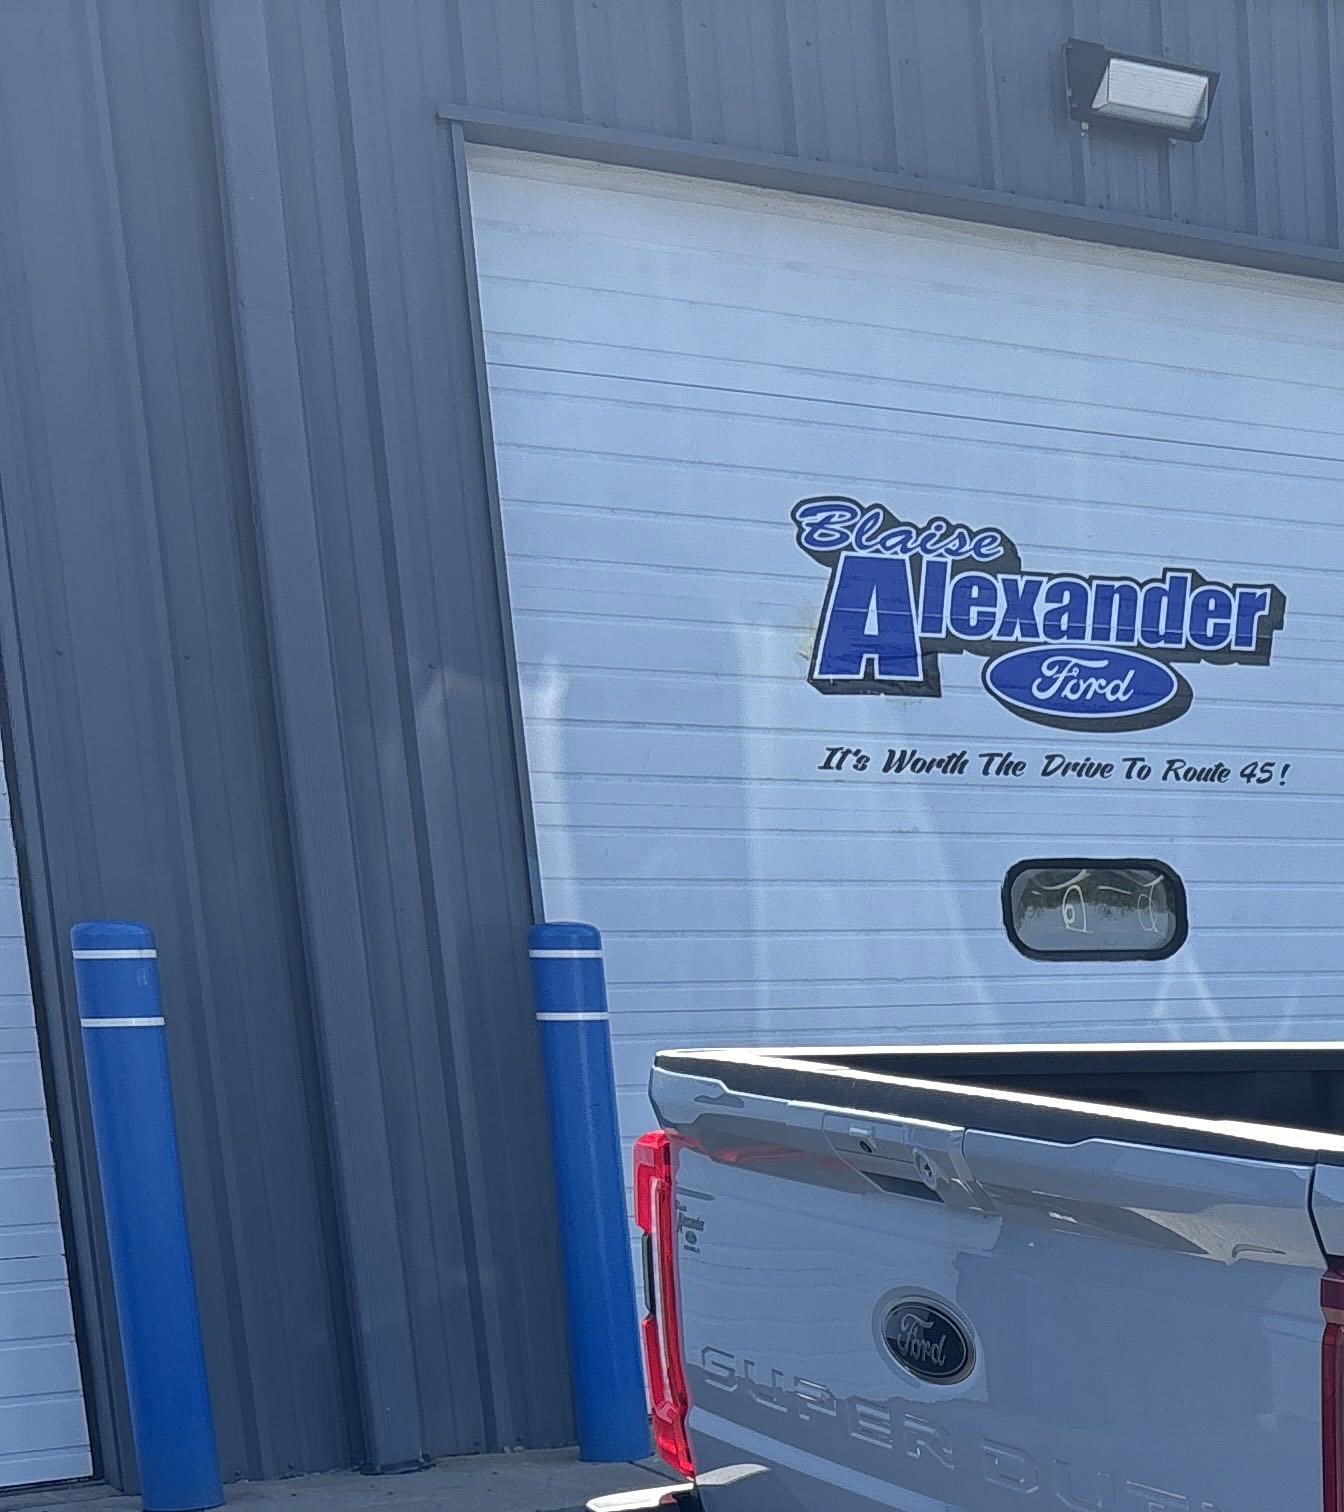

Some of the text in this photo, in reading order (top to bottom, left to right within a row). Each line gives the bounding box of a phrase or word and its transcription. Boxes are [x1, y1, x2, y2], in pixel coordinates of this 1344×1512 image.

[796, 500, 1003, 563] Blaise
[812, 551, 1275, 682] Alexander
[1031, 657, 1135, 702] Ford
[817, 746, 871, 772] It's
[882, 748, 969, 775] Worth
[978, 750, 1026, 777] The
[1040, 753, 1115, 779] Drive
[1122, 757, 1152, 781] To
[1162, 758, 1231, 784] Route
[896, 1312, 947, 1367] Ford
[701, 1345, 955, 1472] SUPER
